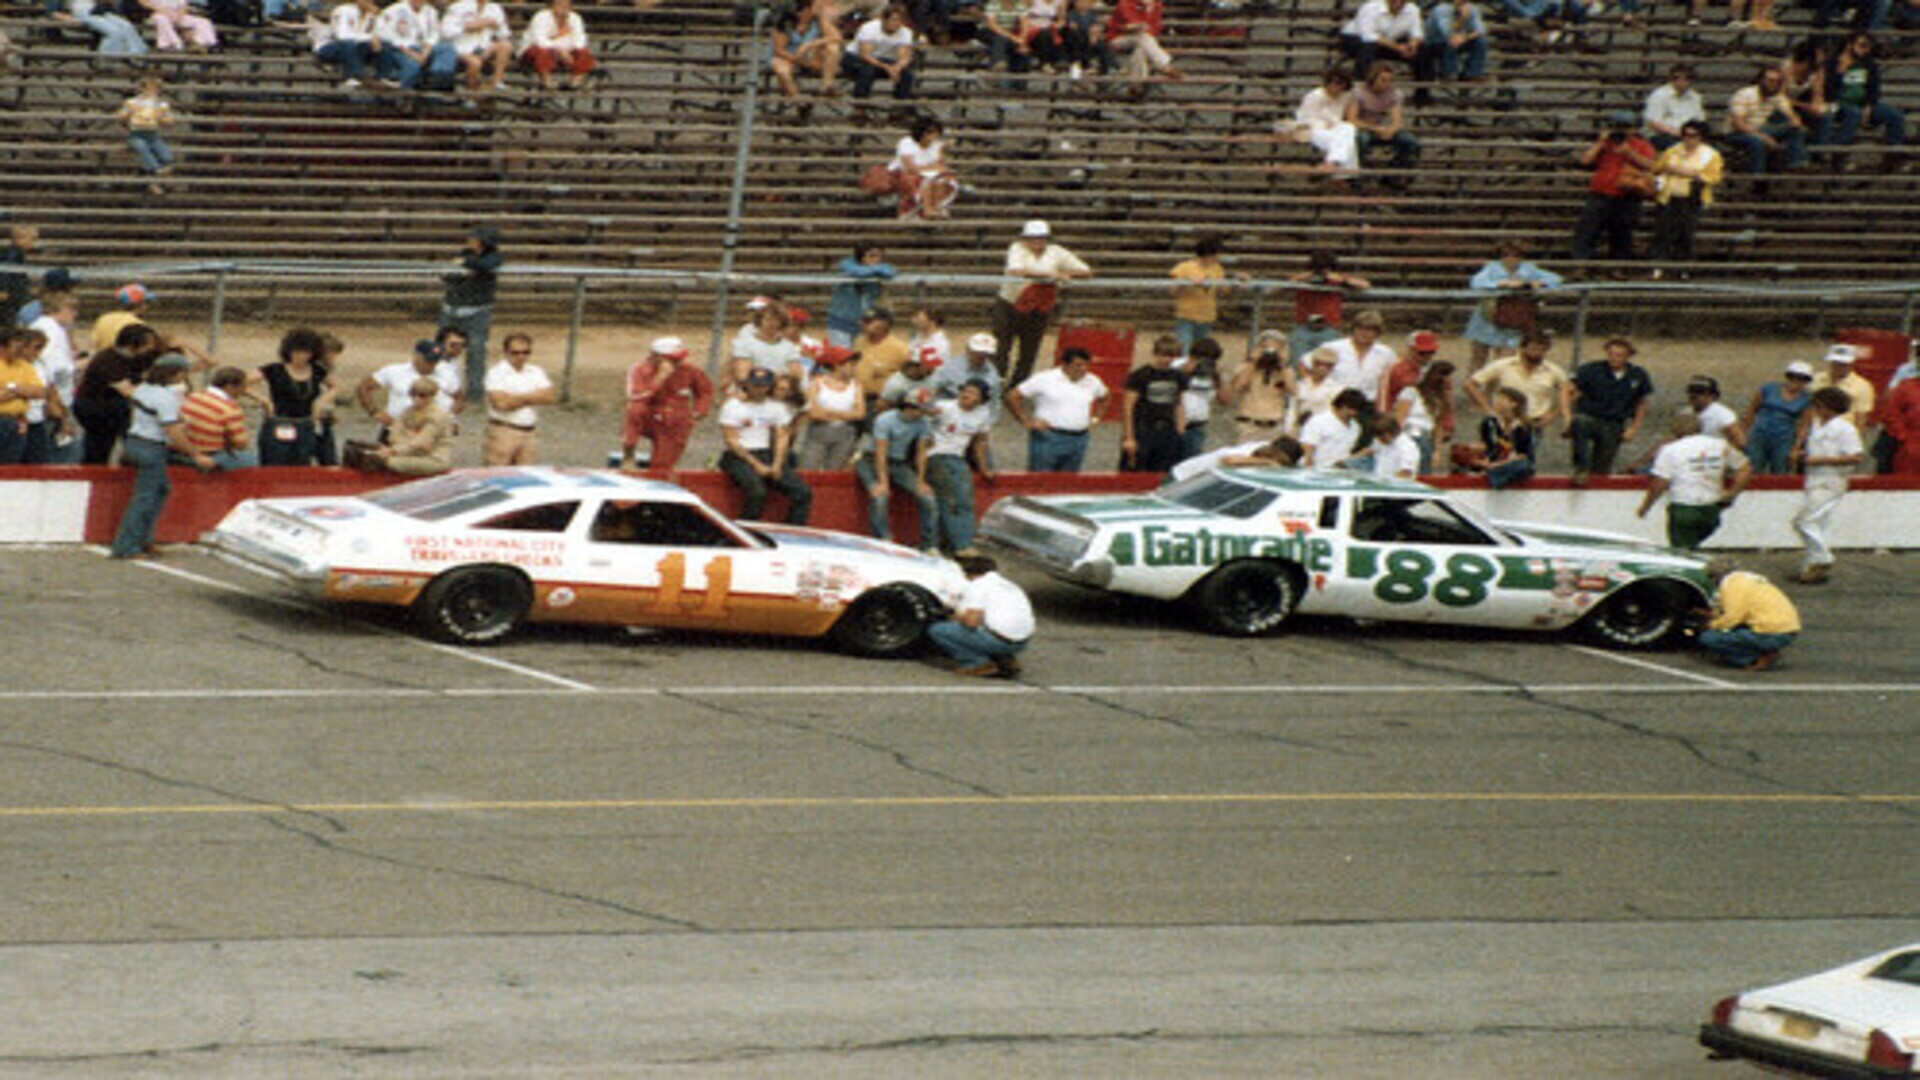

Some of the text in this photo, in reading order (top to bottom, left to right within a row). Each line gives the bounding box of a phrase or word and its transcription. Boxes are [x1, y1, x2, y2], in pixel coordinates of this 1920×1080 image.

[1141, 524, 1334, 572] Gatorade
[1373, 548, 1498, 607] 88
[644, 552, 733, 618] 11
